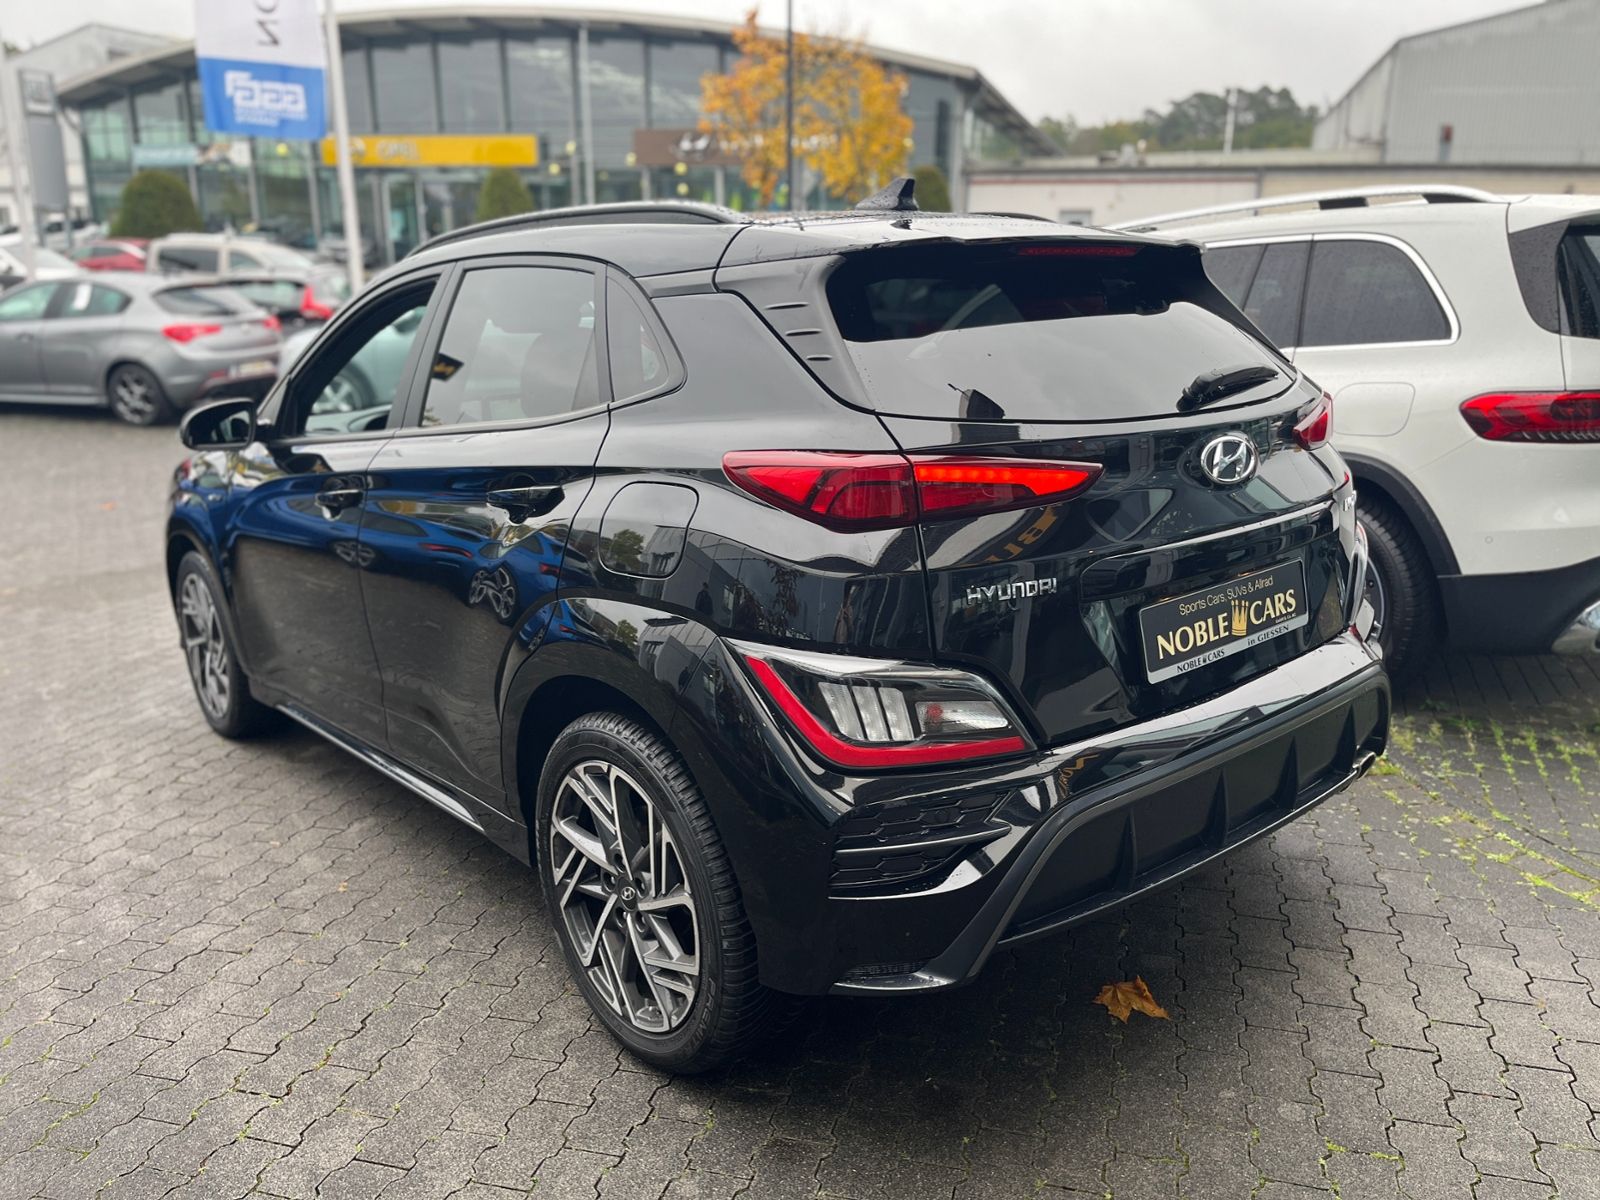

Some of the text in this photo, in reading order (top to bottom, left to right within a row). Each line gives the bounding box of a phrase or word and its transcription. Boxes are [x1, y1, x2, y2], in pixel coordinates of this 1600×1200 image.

[966, 578, 1057, 605] HYUNDAI
[1179, 599, 1207, 616] Sports
[1227, 585, 1247, 600] SUVs
[1247, 582, 1254, 593] &
[1254, 575, 1274, 591] Allrad
[1156, 589, 1297, 660] NOBLE CARS
[1177, 625, 1290, 673] NOBLE CARS in GIESSEN
